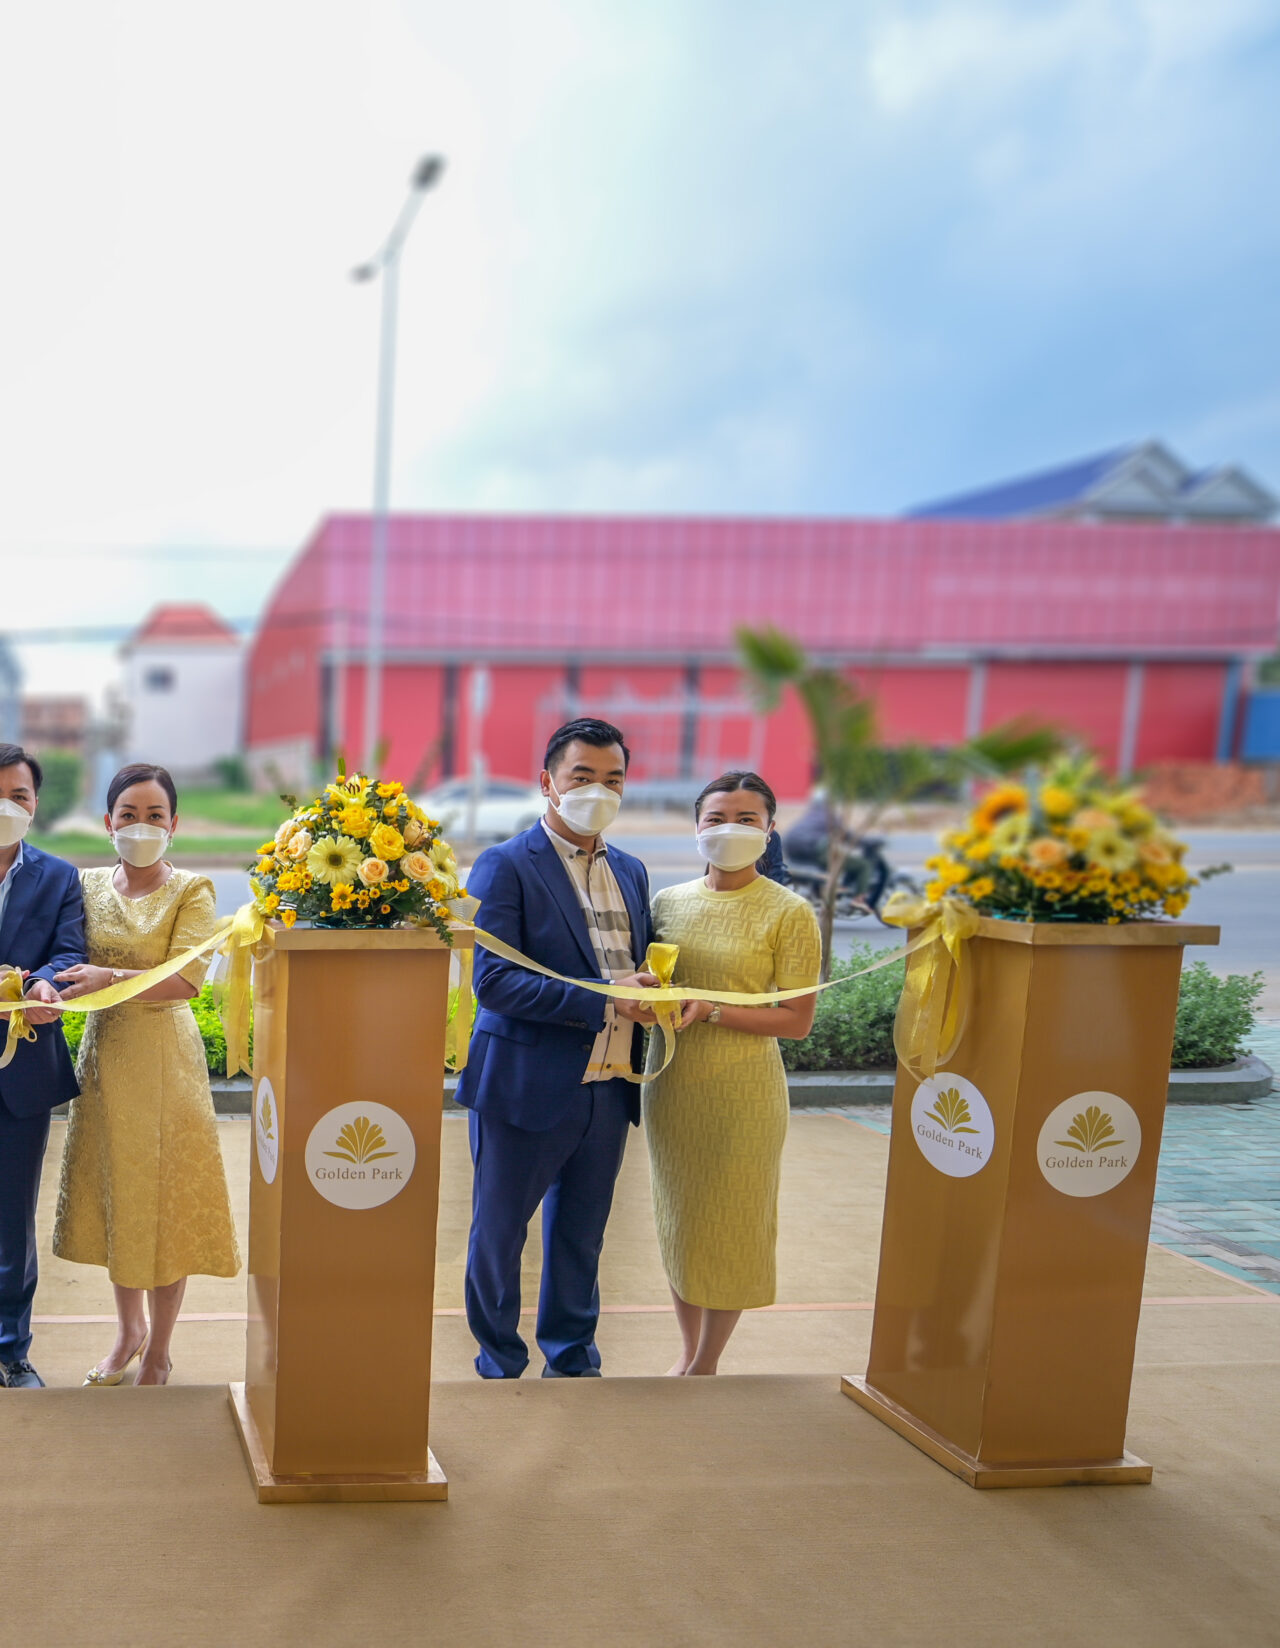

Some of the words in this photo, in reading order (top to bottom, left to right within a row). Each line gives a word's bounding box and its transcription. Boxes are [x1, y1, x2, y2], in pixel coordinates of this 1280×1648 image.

[916, 1123, 955, 1148] Golden
[957, 1139, 984, 1160] Park
[1045, 1156, 1093, 1169] Golden
[1098, 1155, 1128, 1168] Park
[315, 1167, 366, 1180] Golden
[372, 1167, 403, 1180] Park
